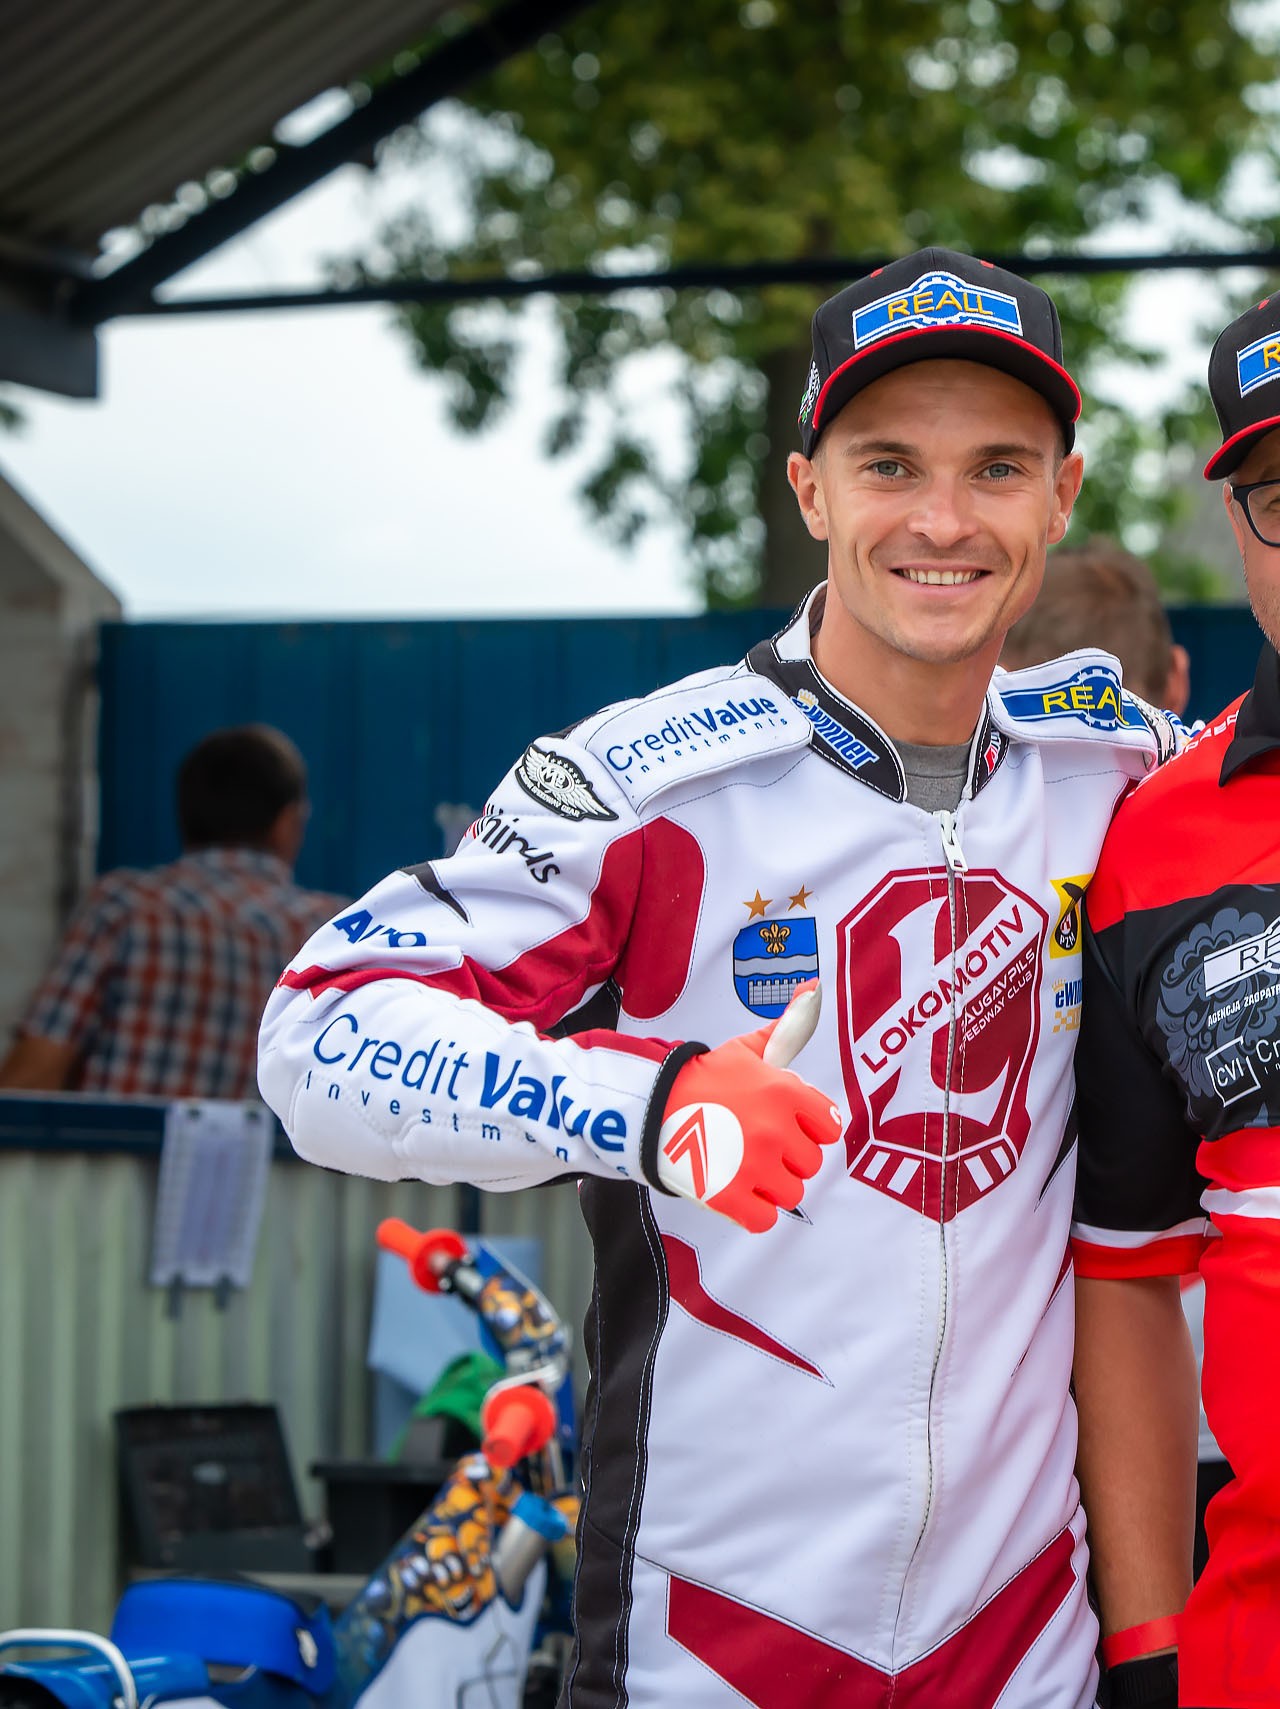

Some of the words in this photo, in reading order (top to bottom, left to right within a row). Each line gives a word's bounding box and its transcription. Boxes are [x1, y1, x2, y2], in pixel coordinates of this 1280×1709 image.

[888, 290, 994, 321] REALL
[1042, 686, 1130, 726] REAL
[860, 904, 1024, 1074] LOKOMOTIV
[960, 948, 1035, 1030] AUGAVPILS
[1007, 969, 1033, 1000] CLUB
[1208, 1001, 1241, 1027] AGENCJA
[1216, 1057, 1245, 1087] CVI
